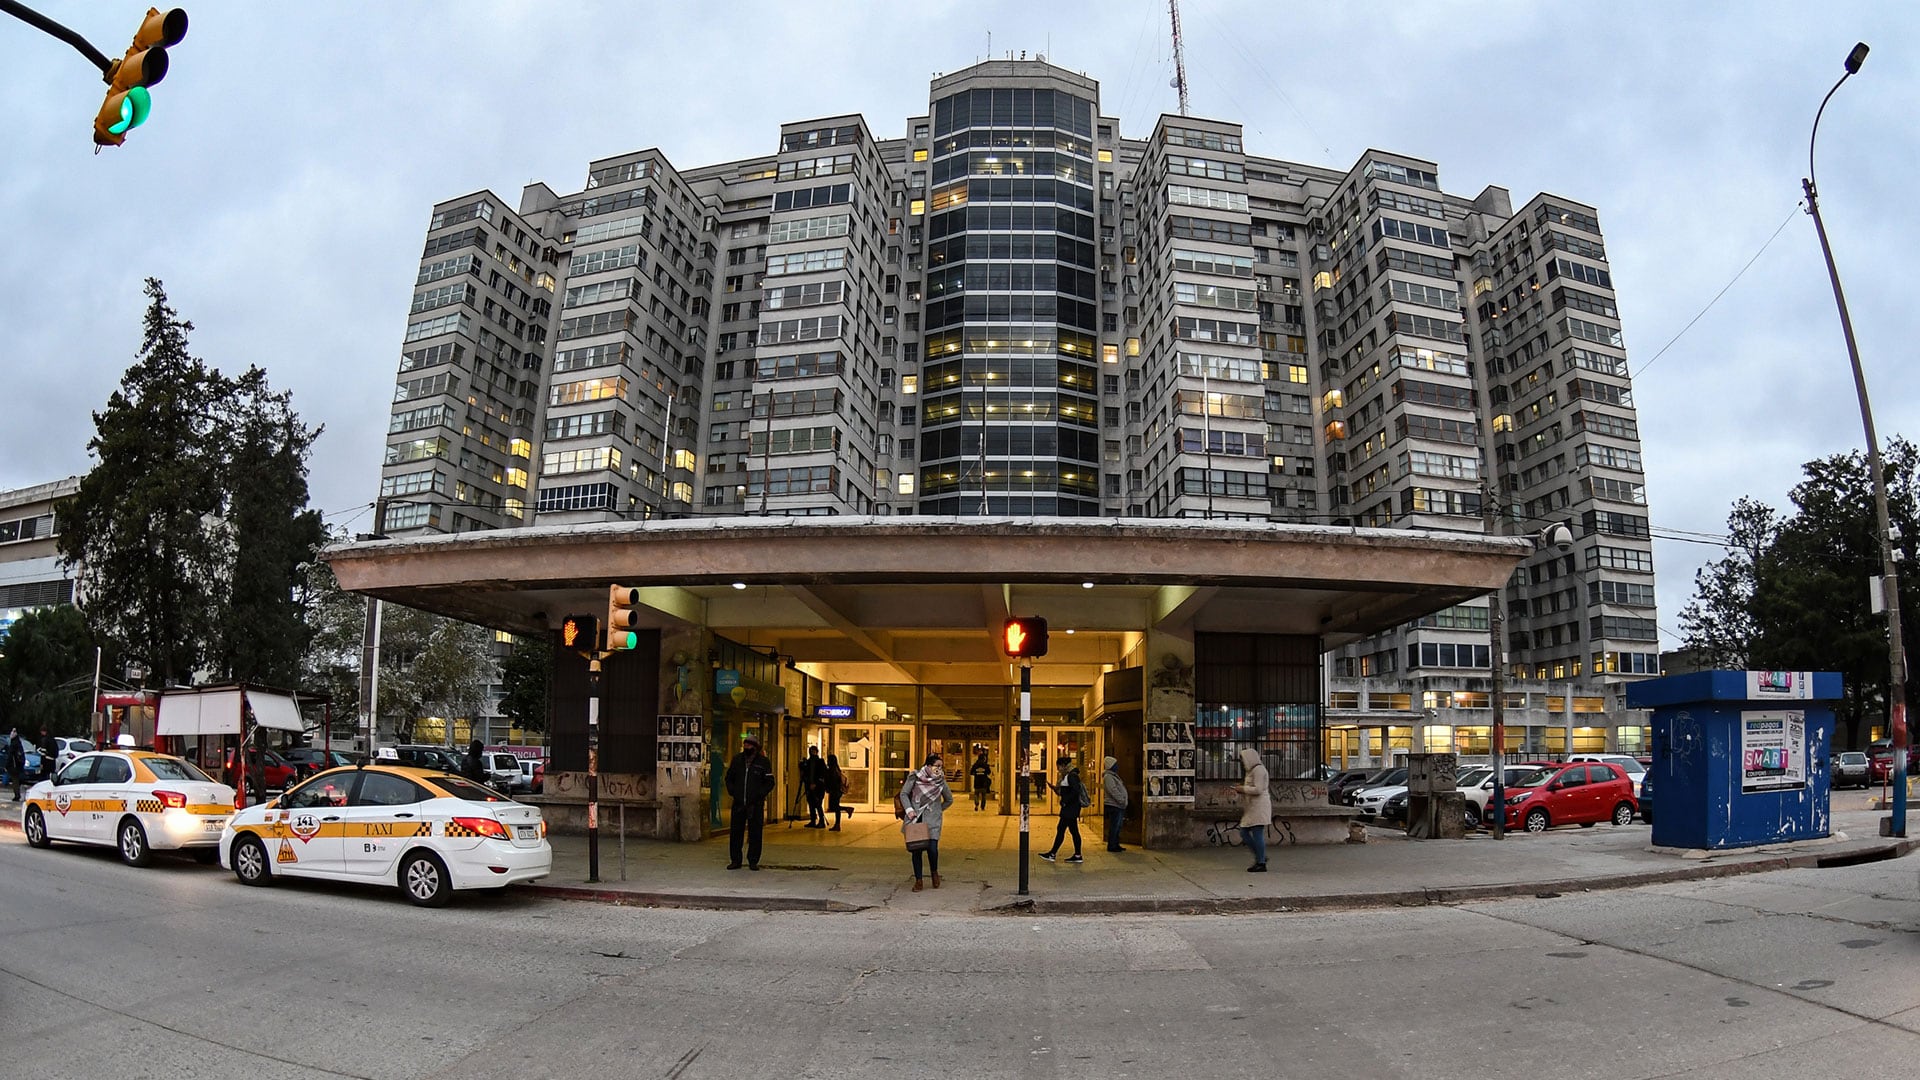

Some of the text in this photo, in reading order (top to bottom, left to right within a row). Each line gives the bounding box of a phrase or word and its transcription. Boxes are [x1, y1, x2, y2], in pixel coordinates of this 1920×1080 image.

[1760, 672, 1791, 683] SMART
[1745, 750, 1787, 766] SMART
[90, 801, 106, 810] TAXI
[297, 816, 313, 826] 141
[363, 823, 393, 835] TAXI
